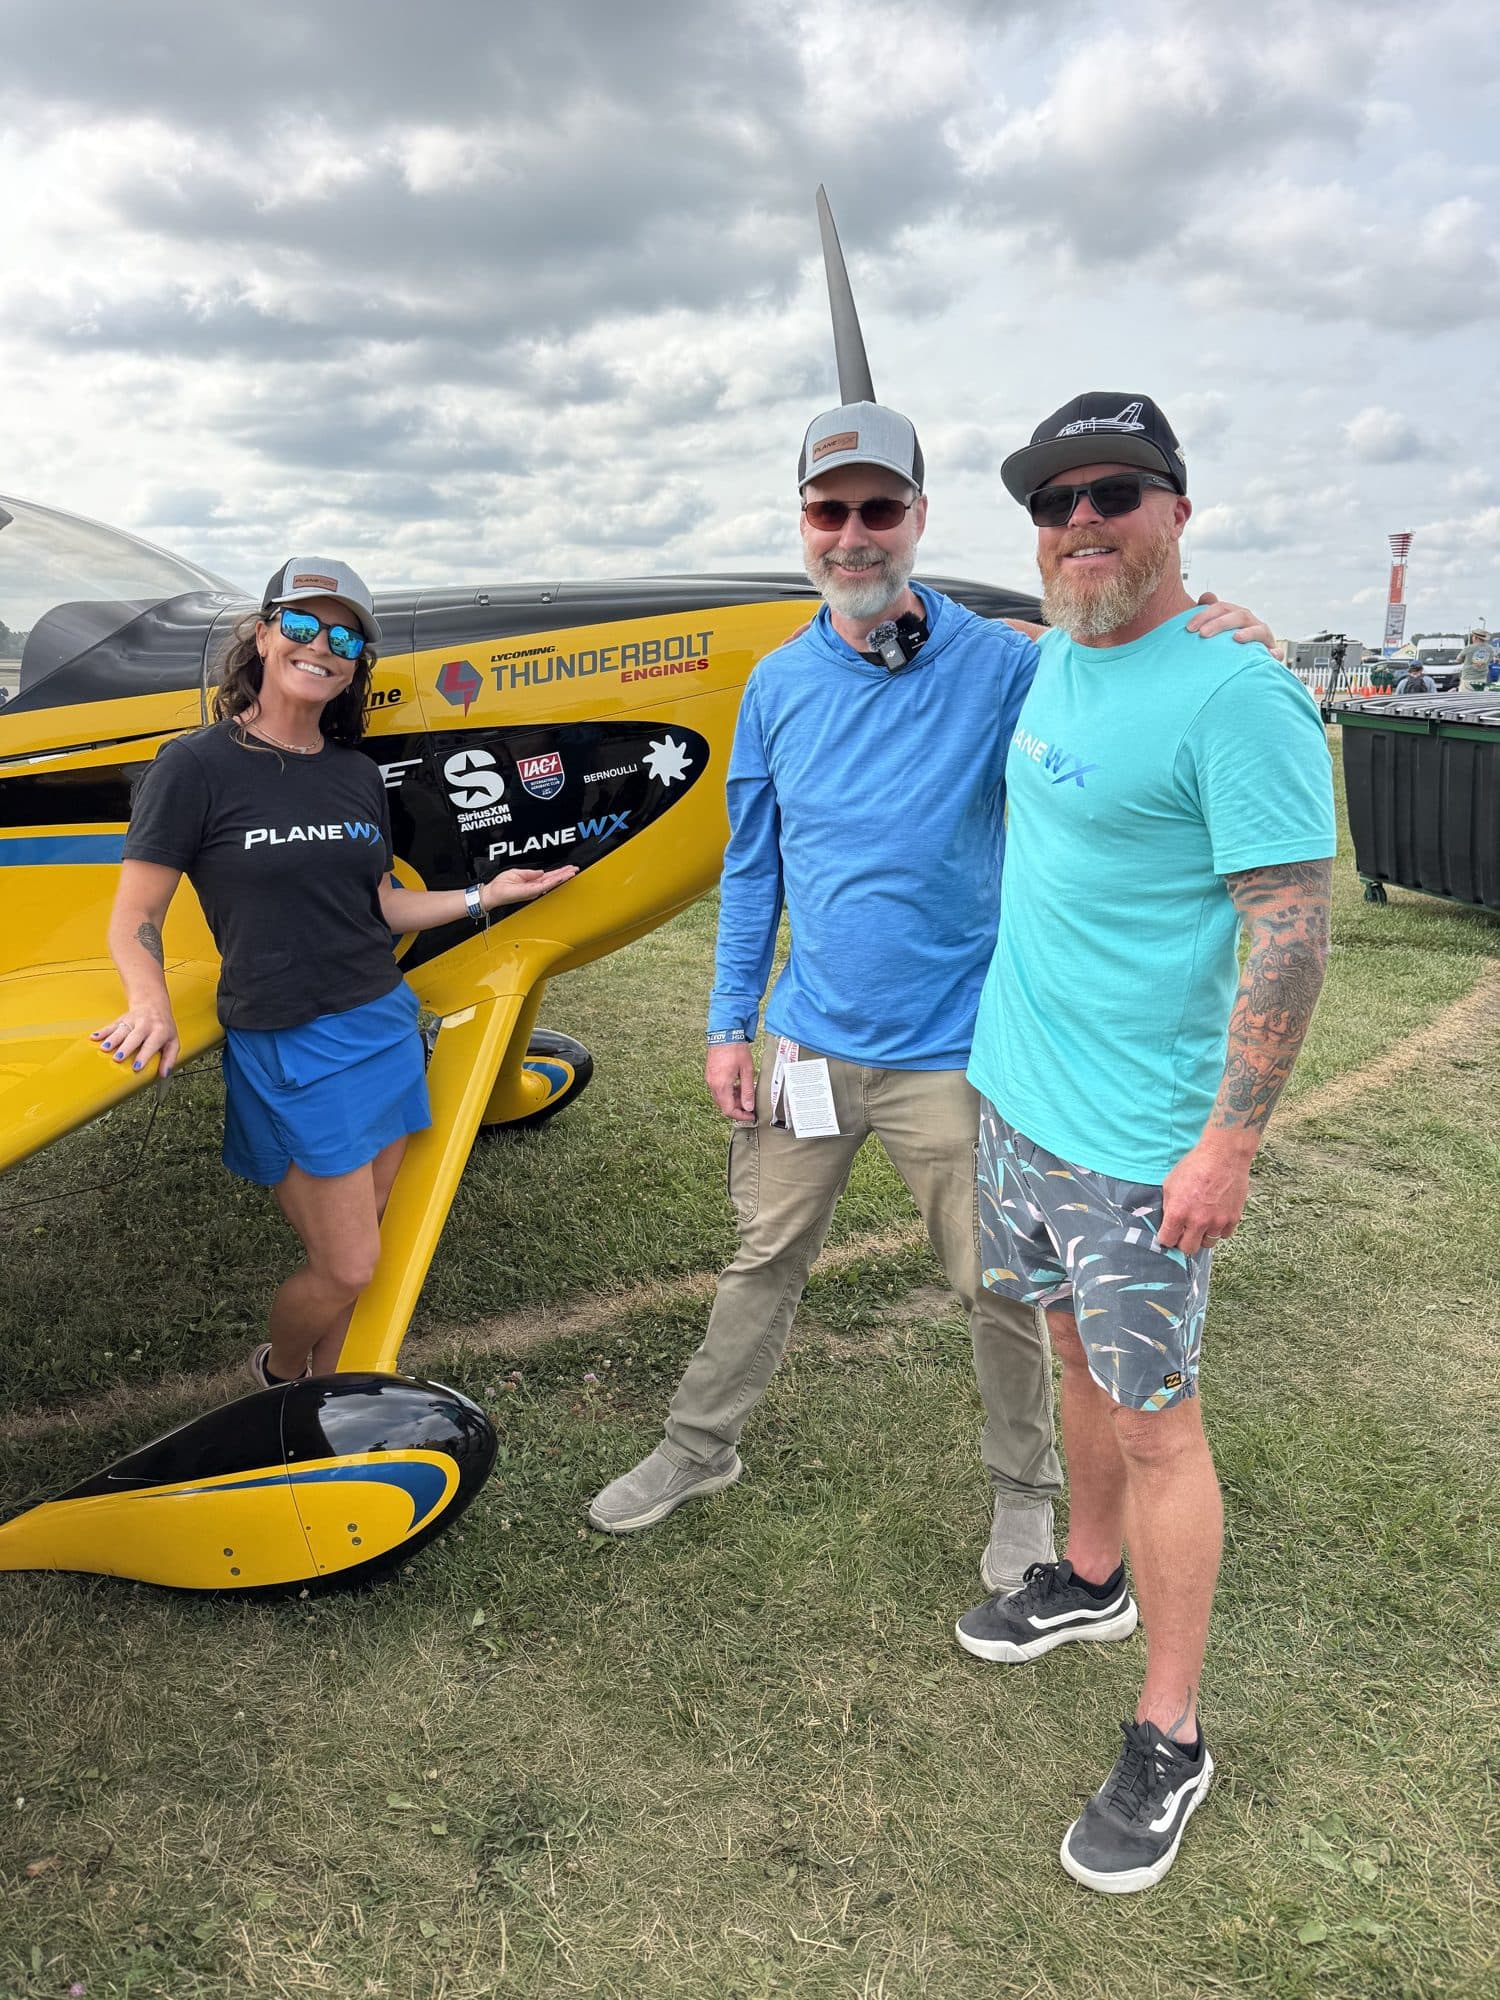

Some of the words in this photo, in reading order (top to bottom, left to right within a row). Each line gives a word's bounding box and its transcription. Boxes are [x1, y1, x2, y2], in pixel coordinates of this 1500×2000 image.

[490, 645, 556, 662] LYCOMING
[490, 630, 714, 691] THUNDERBOLT
[620, 658, 709, 683] ENGINES
[1012, 727, 1101, 788] ANEWX
[583, 763, 639, 784] BERNOULLI
[457, 803, 510, 823] SiriusXM
[461, 813, 512, 832] AVIATION
[244, 821, 384, 850] PLANEWX
[488, 809, 632, 862] PLANEWX
